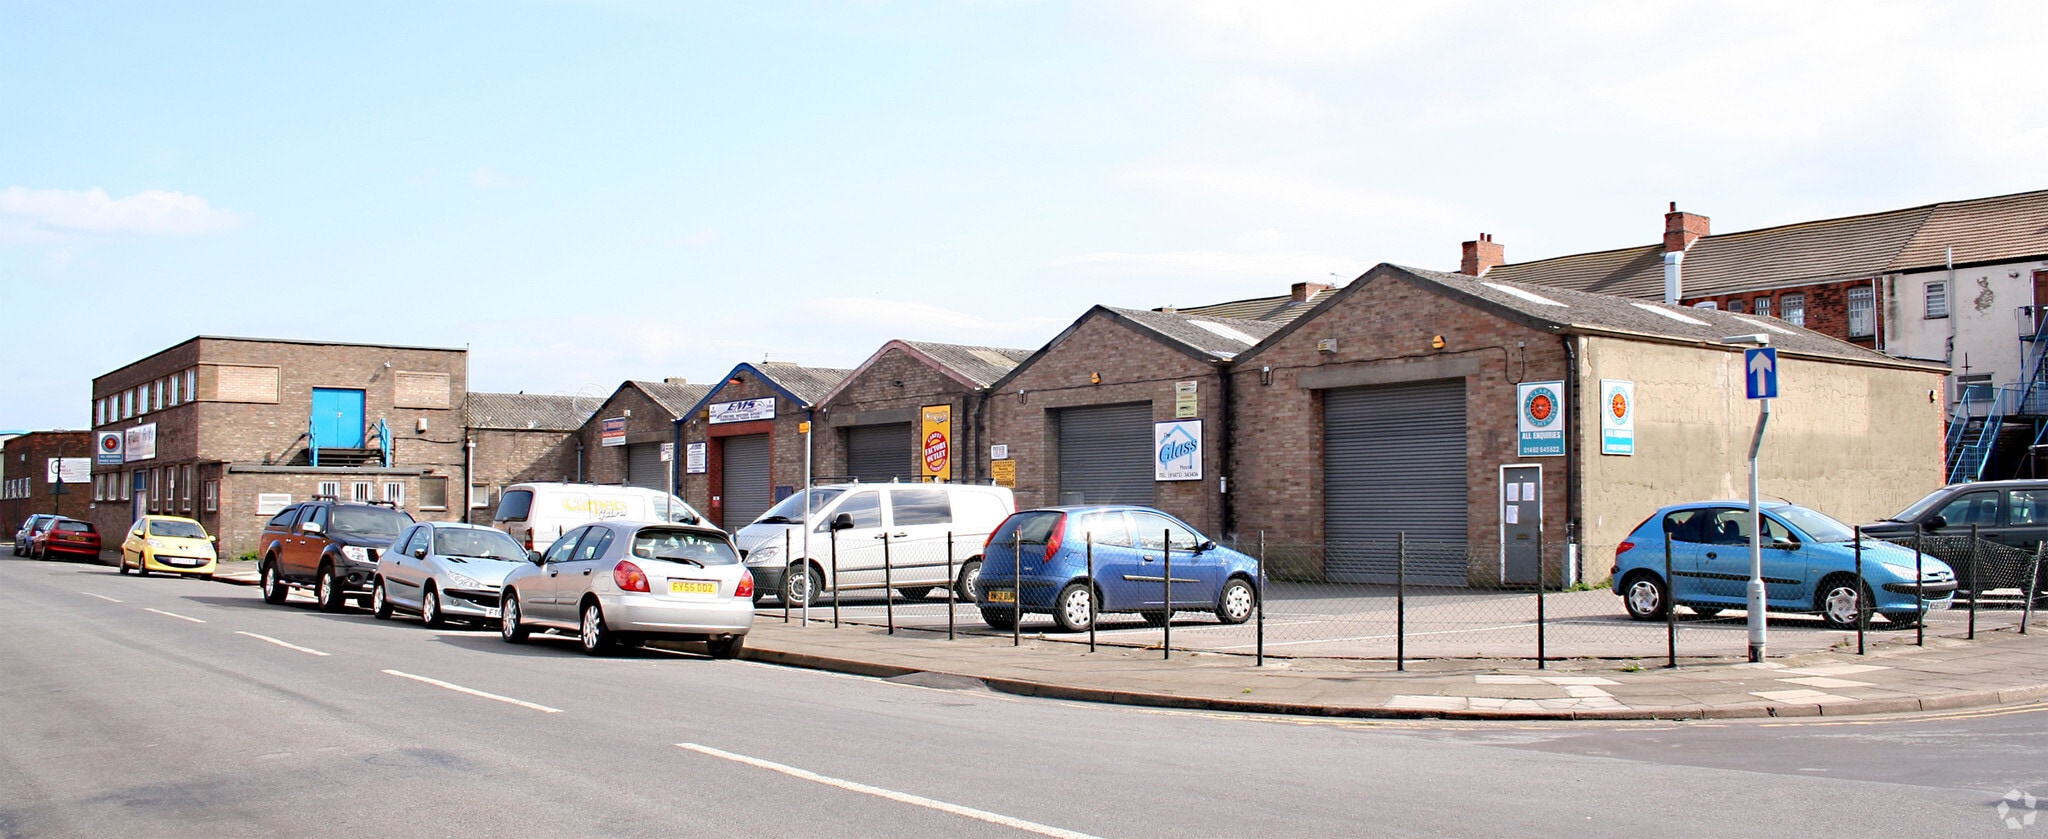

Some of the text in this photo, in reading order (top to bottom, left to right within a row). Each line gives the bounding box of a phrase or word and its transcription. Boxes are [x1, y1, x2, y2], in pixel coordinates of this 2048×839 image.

[727, 400, 755, 411] EMS
[1521, 431, 1561, 440] ALL ENQUIRIES
[924, 441, 947, 456] FACTORY
[1159, 439, 1198, 464] Glass
[926, 449, 946, 463] OUTLET
[562, 497, 628, 515] Carpets
[672, 582, 695, 592] FY55
